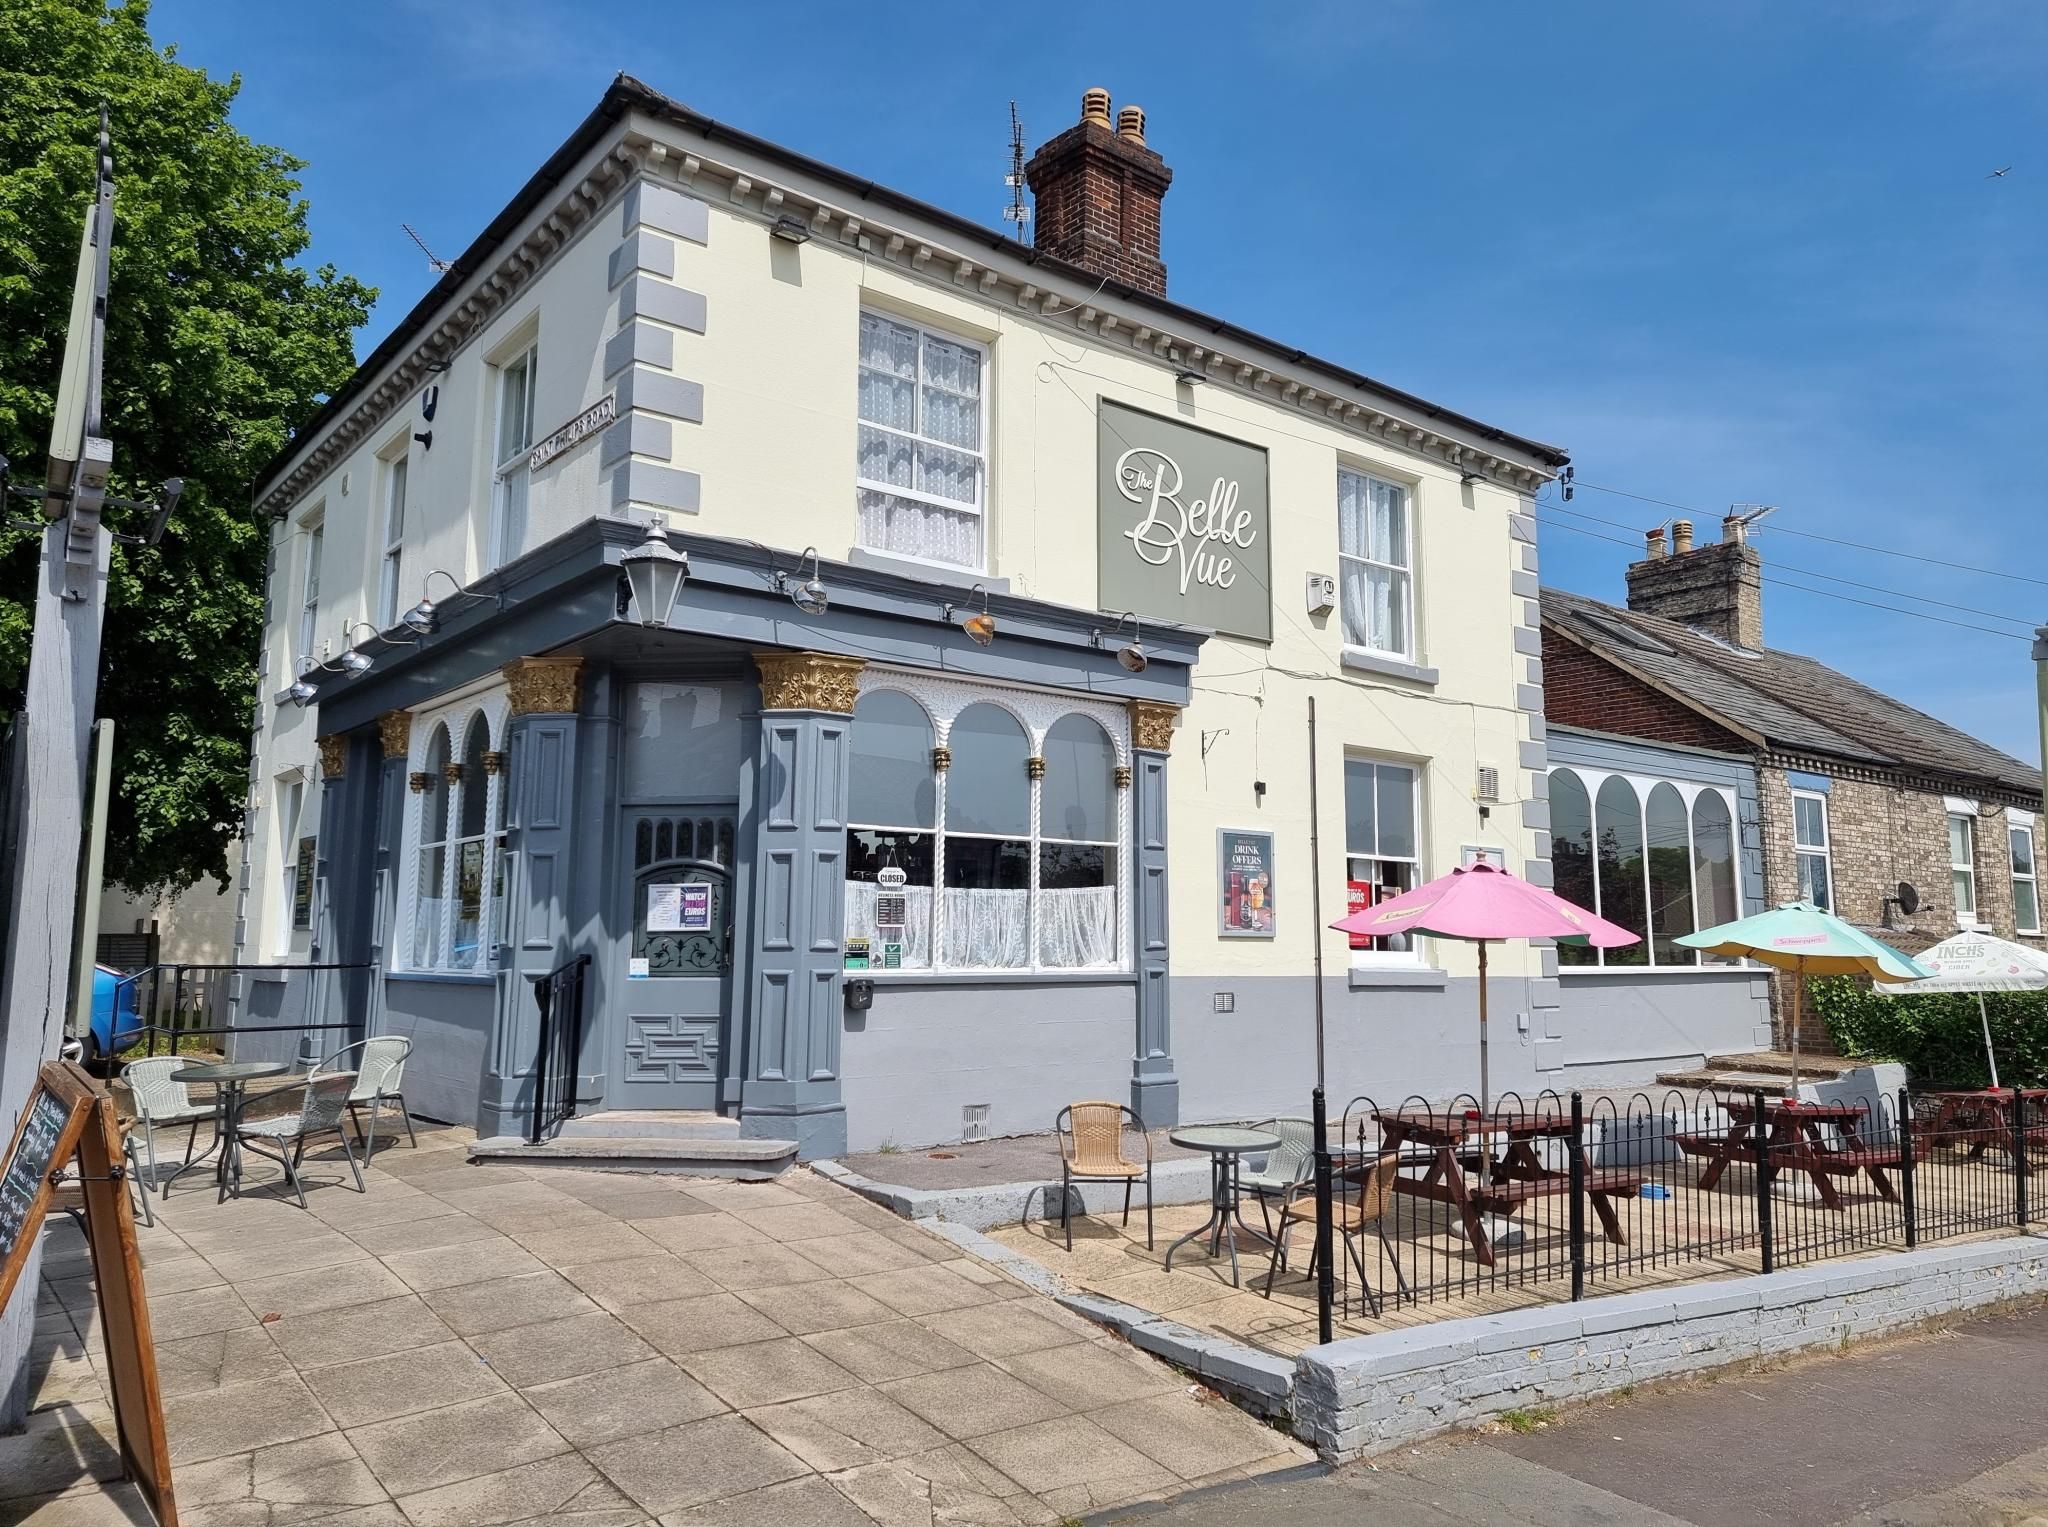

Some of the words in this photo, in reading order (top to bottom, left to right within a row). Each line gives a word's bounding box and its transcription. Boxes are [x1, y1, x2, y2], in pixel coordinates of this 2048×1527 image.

[532, 439, 554, 465] SAINT
[555, 419, 585, 451] PHILIPS
[586, 402, 612, 431] ROAD
[1121, 466, 1153, 490] The
[1115, 447, 1257, 549] Belle
[1132, 519, 1236, 597] Vue
[1234, 844, 1259, 855] DRINK
[1232, 854, 1262, 865] OFFERS
[880, 874, 904, 883] CLOSED
[685, 892, 706, 901] WATCH
[684, 907, 706, 916] EUROS
